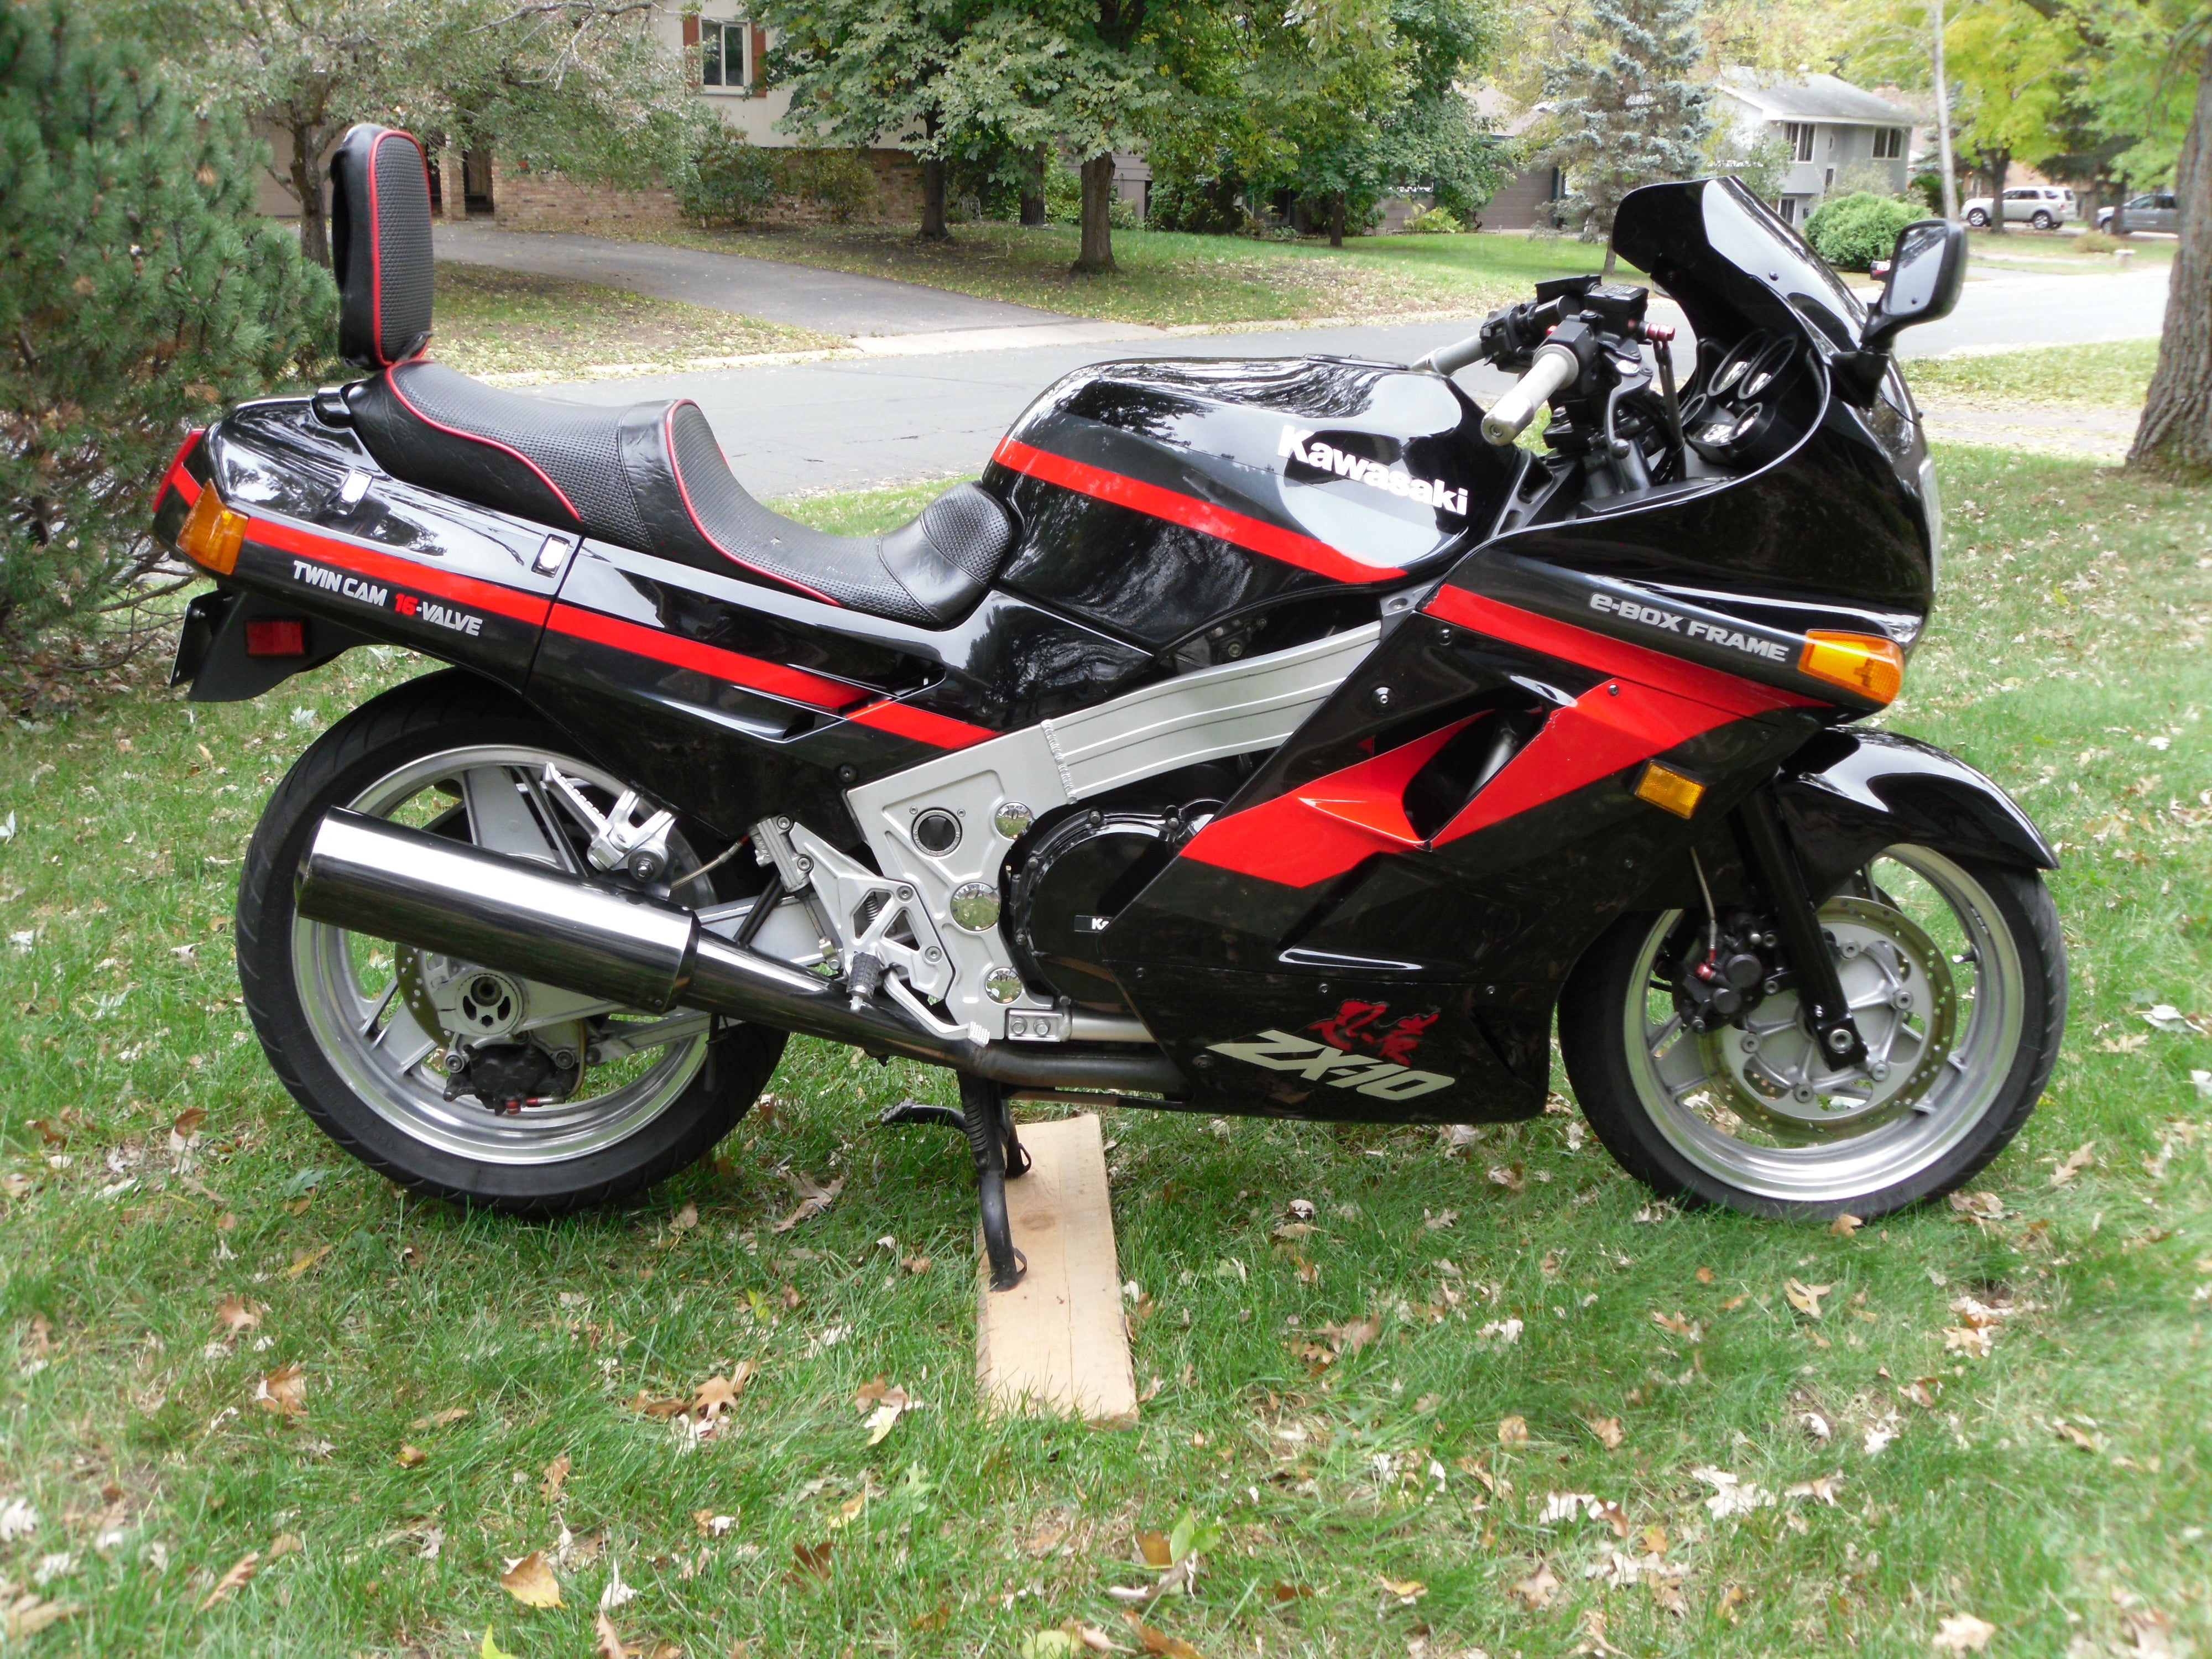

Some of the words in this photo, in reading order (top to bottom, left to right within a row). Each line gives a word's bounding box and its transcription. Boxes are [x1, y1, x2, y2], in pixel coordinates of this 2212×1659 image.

[1279, 425, 1468, 515] Kawasaki
[293, 560, 342, 592] TWIN
[343, 578, 388, 606] CAM
[395, 594, 483, 636] 16-VALVE
[1590, 593, 1683, 632] e-BOX
[1687, 621, 1789, 661] FRAME
[1205, 1029, 1455, 1100] ZX-10
